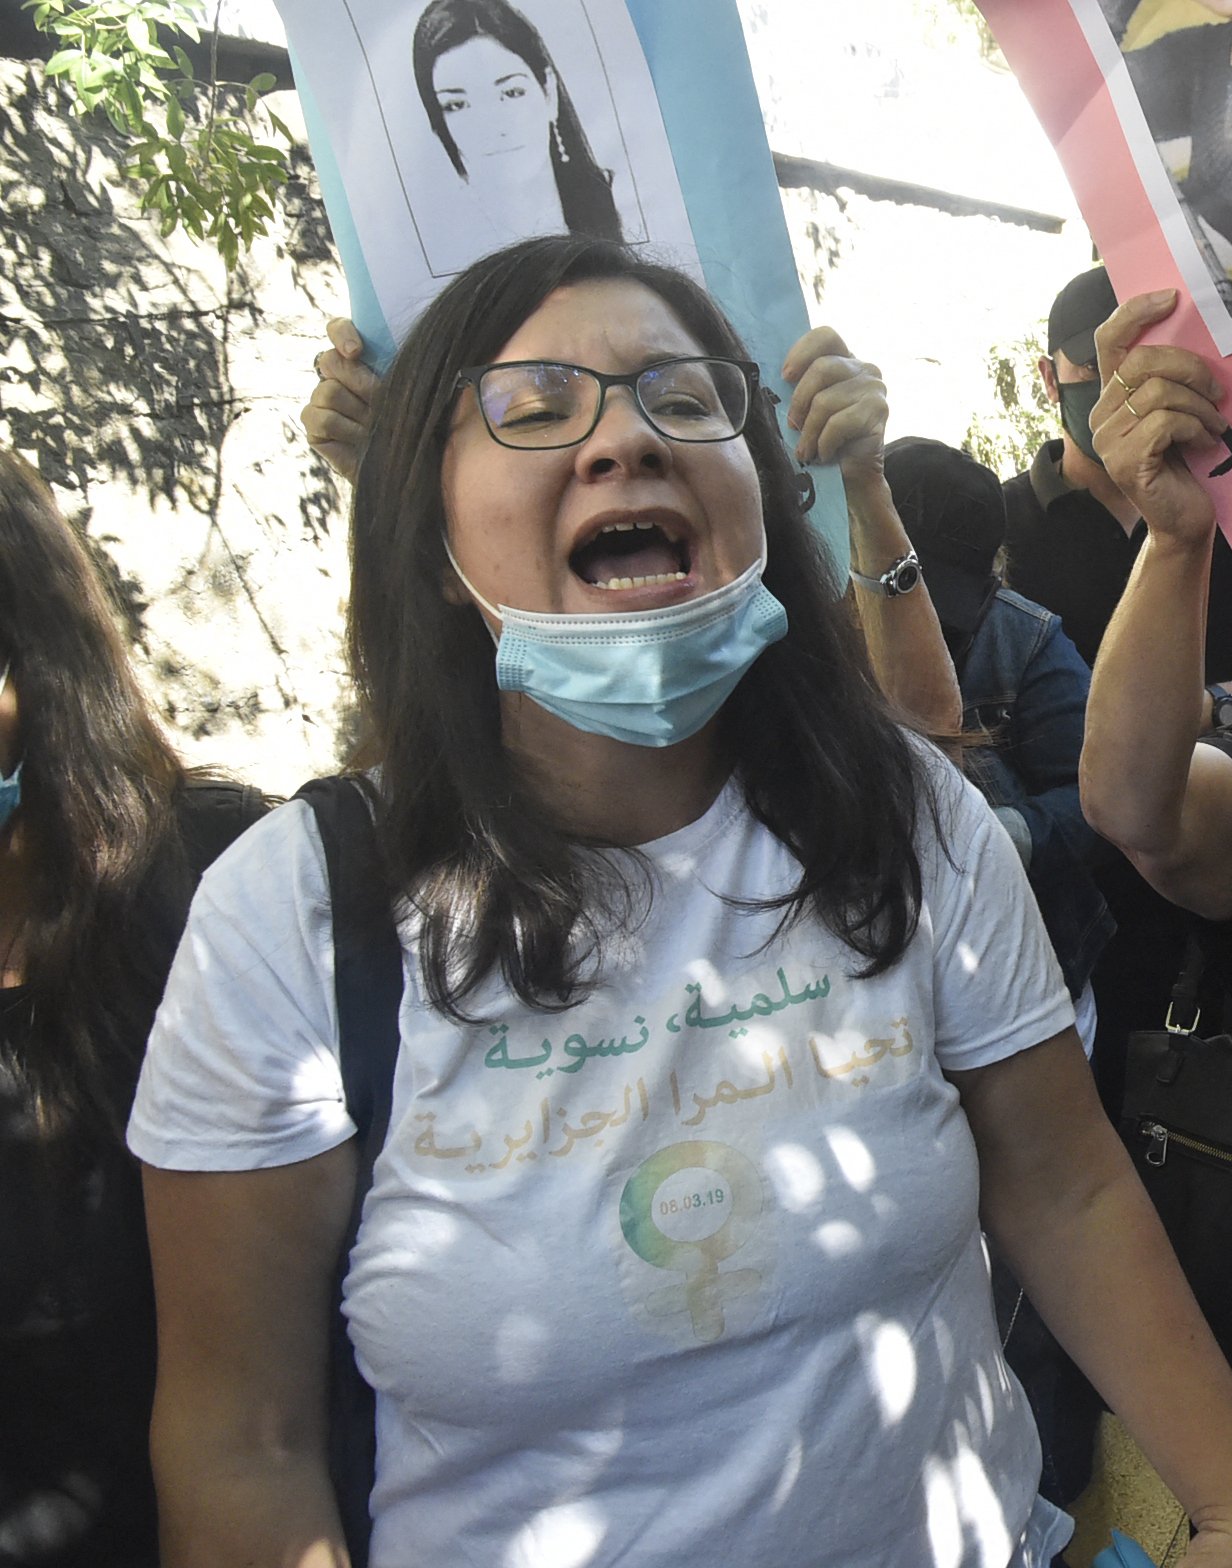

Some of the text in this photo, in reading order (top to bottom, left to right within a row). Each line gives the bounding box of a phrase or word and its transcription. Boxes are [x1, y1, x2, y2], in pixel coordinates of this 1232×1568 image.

[483, 966, 832, 1081] سلمية، نسوية
[413, 1016, 914, 1174] تحيا المرا الجزايرية
[660, 1188, 724, 1215] 08.03.19
